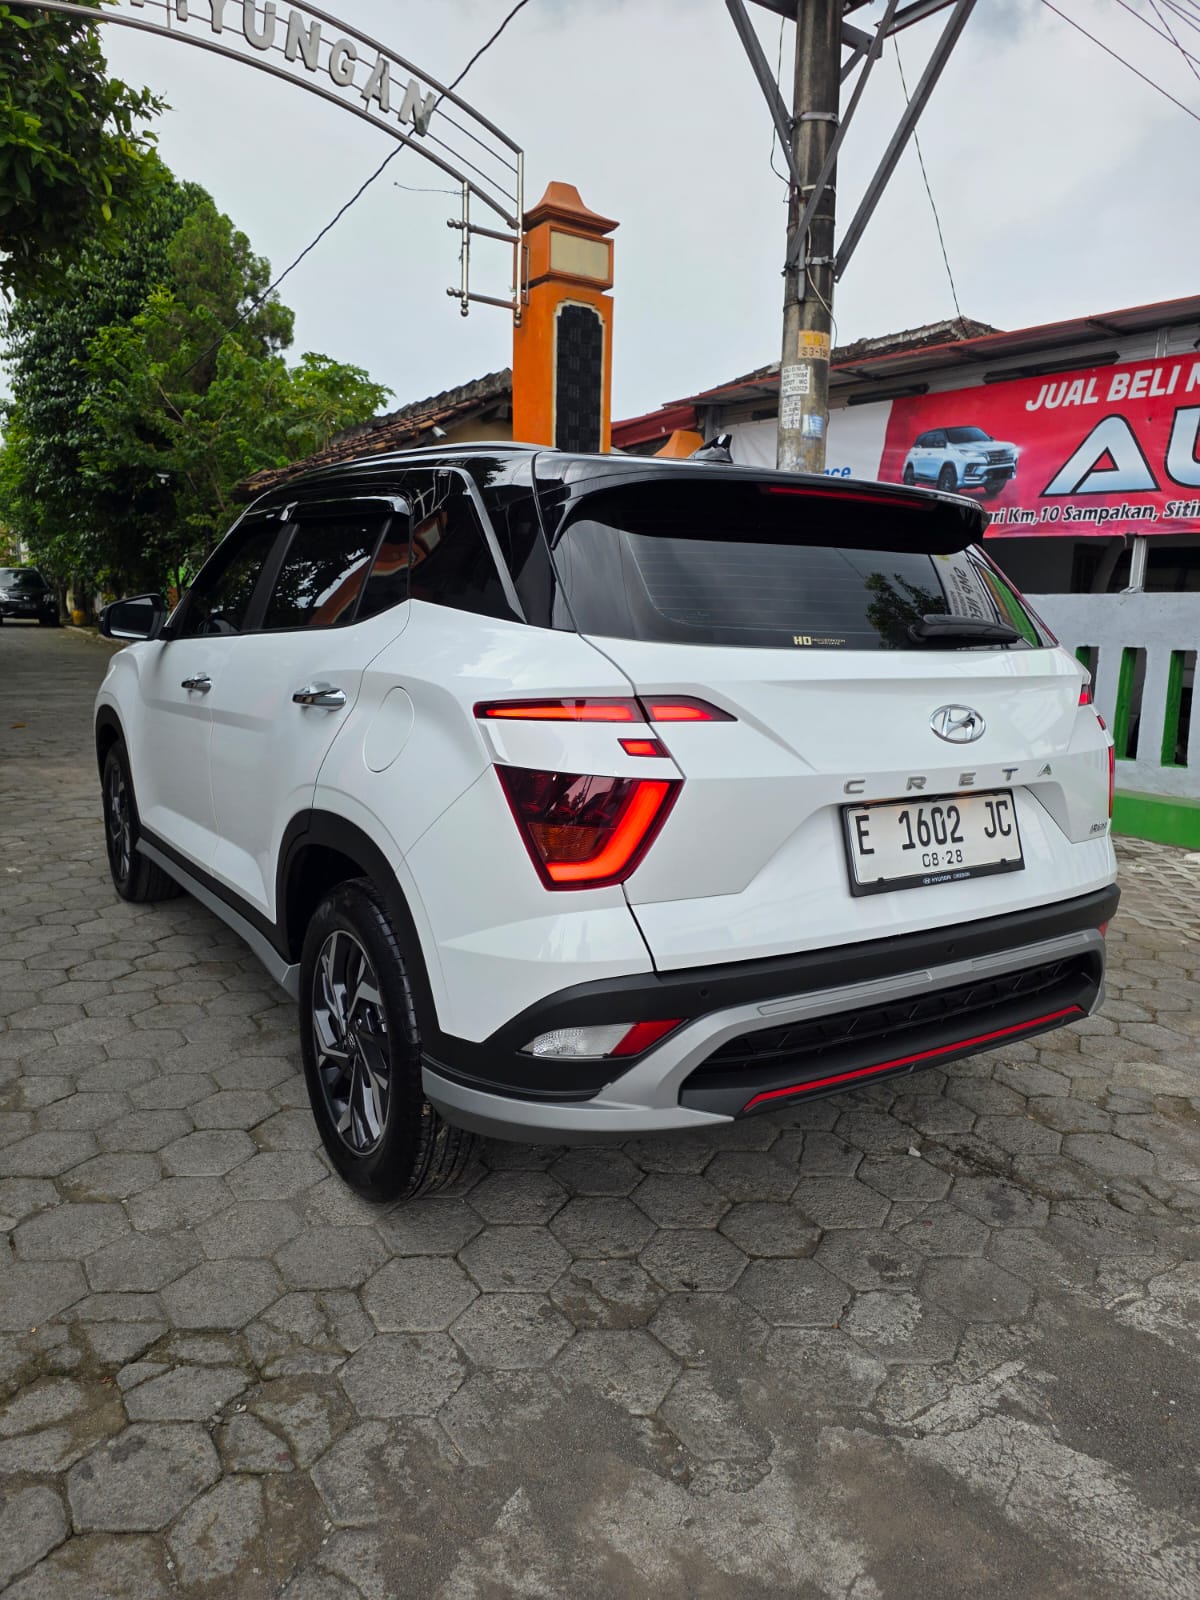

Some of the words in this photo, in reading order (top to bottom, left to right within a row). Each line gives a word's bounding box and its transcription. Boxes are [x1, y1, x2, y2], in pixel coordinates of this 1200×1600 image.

[130, 0, 437, 138] YUNGAN
[1025, 377, 1099, 412] JUAL
[1106, 364, 1181, 402] BELI
[1062, 501, 1160, 527] Sampakan,
[793, 635, 812, 646] HD
[843, 763, 1053, 795] CRETA
[854, 814, 875, 855] E
[898, 805, 965, 851] 1602
[984, 800, 1013, 838] JC
